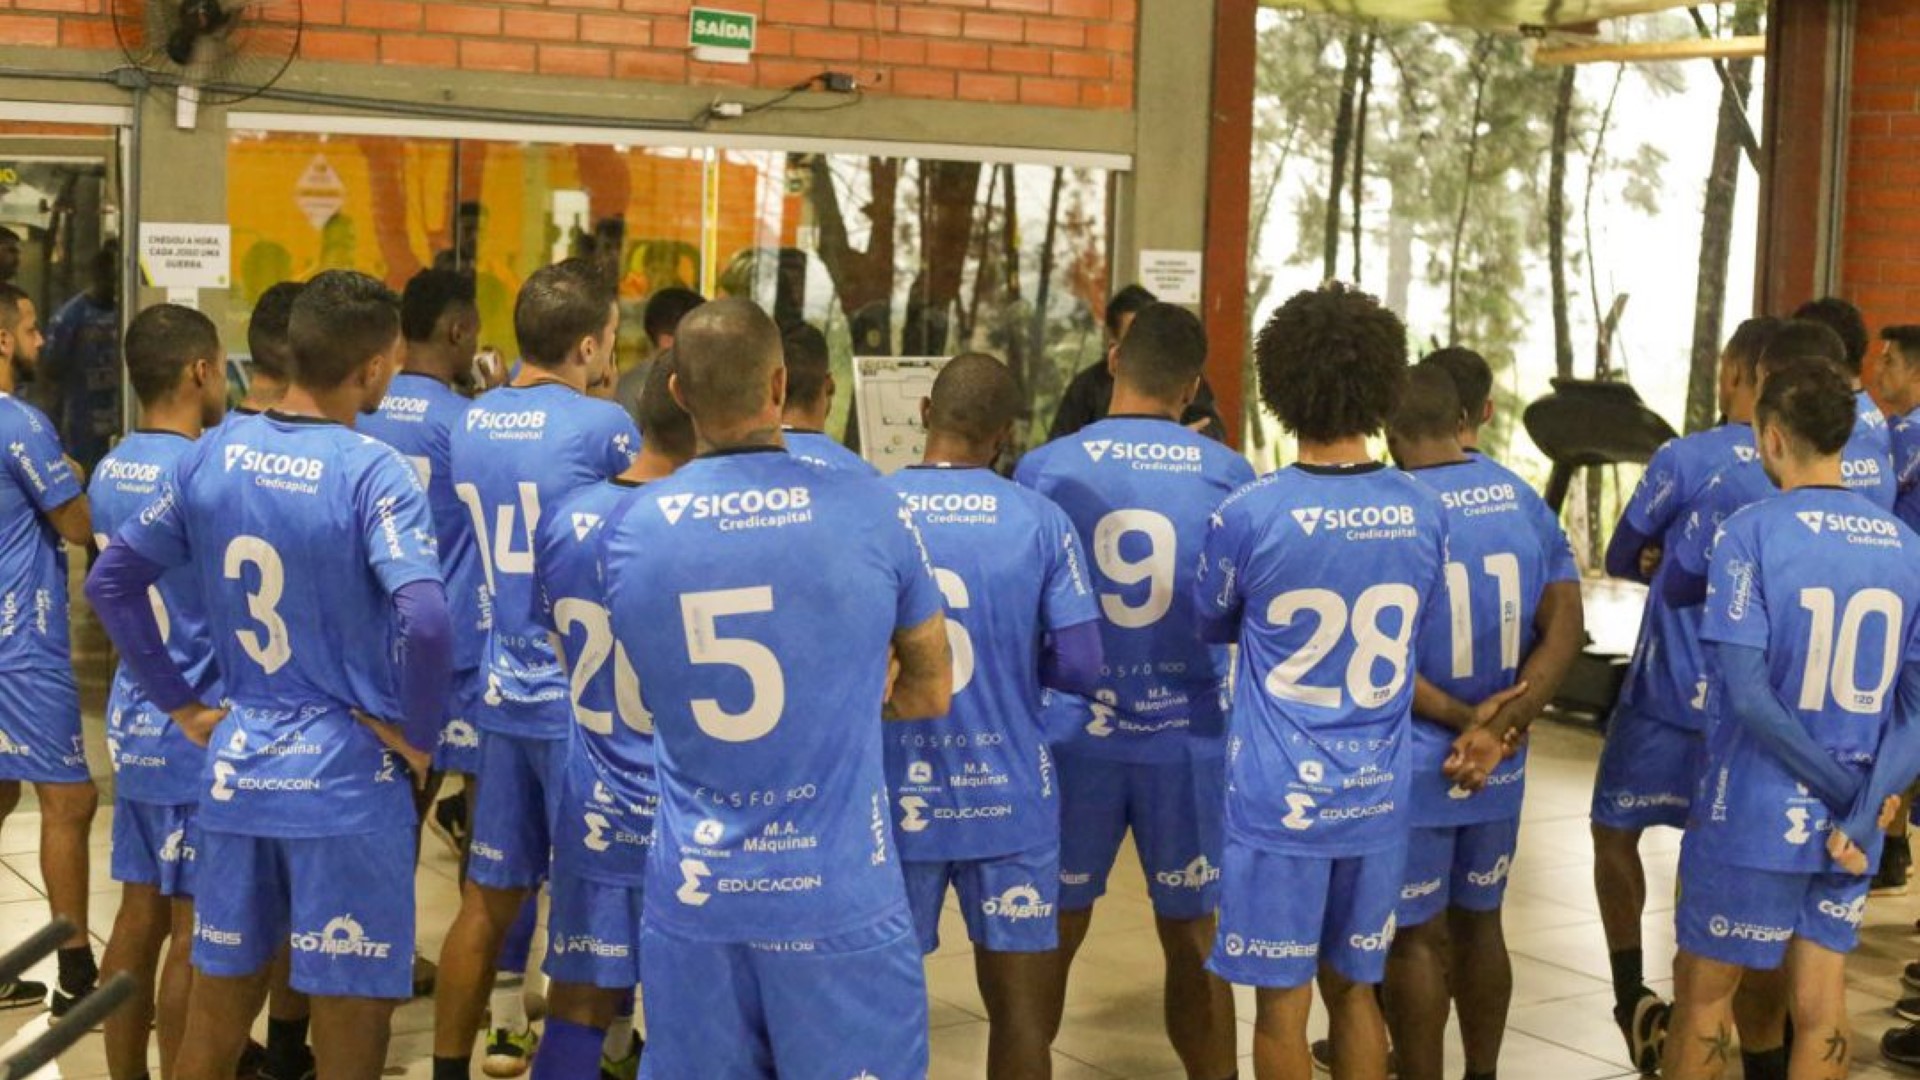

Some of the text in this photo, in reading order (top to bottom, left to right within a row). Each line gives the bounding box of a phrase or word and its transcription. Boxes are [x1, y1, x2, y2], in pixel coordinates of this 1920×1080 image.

[695, 19, 750, 40] SAÍDA
[187, 237, 193, 245] A
[479, 410, 547, 430] SICOOB
[490, 431, 543, 441] Credicapital
[1111, 442, 1201, 462] SICOOB
[108, 461, 160, 482] SICOOB
[241, 450, 324, 481] SICOOB
[1131, 461, 1202, 473] Credicapital
[254, 475, 319, 496] Credicapital
[1441, 484, 1515, 508] SICOOB
[692, 486, 812, 519] SICOOB
[907, 494, 997, 512] SICOOB
[718, 509, 813, 531] Credicapital
[926, 513, 997, 525] Credicapital
[1323, 505, 1415, 530] SICOOB
[1827, 513, 1899, 538] SICOOB
[1346, 526, 1417, 541] Credicapital
[1093, 508, 1177, 629] 9
[223, 534, 292, 676] 3
[1446, 552, 1522, 680] 11
[1264, 582, 1419, 709] 28
[1798, 586, 1903, 714] 10
[679, 584, 785, 743] 5
[236, 777, 321, 791] EDUCACOIN
[933, 805, 1012, 819] EDUCACOIN
[1319, 801, 1394, 819] EDUCACOIN
[763, 821, 800, 837] M.A.
[743, 834, 818, 853] Máquinas
[716, 875, 822, 893] EDUCACOIN
